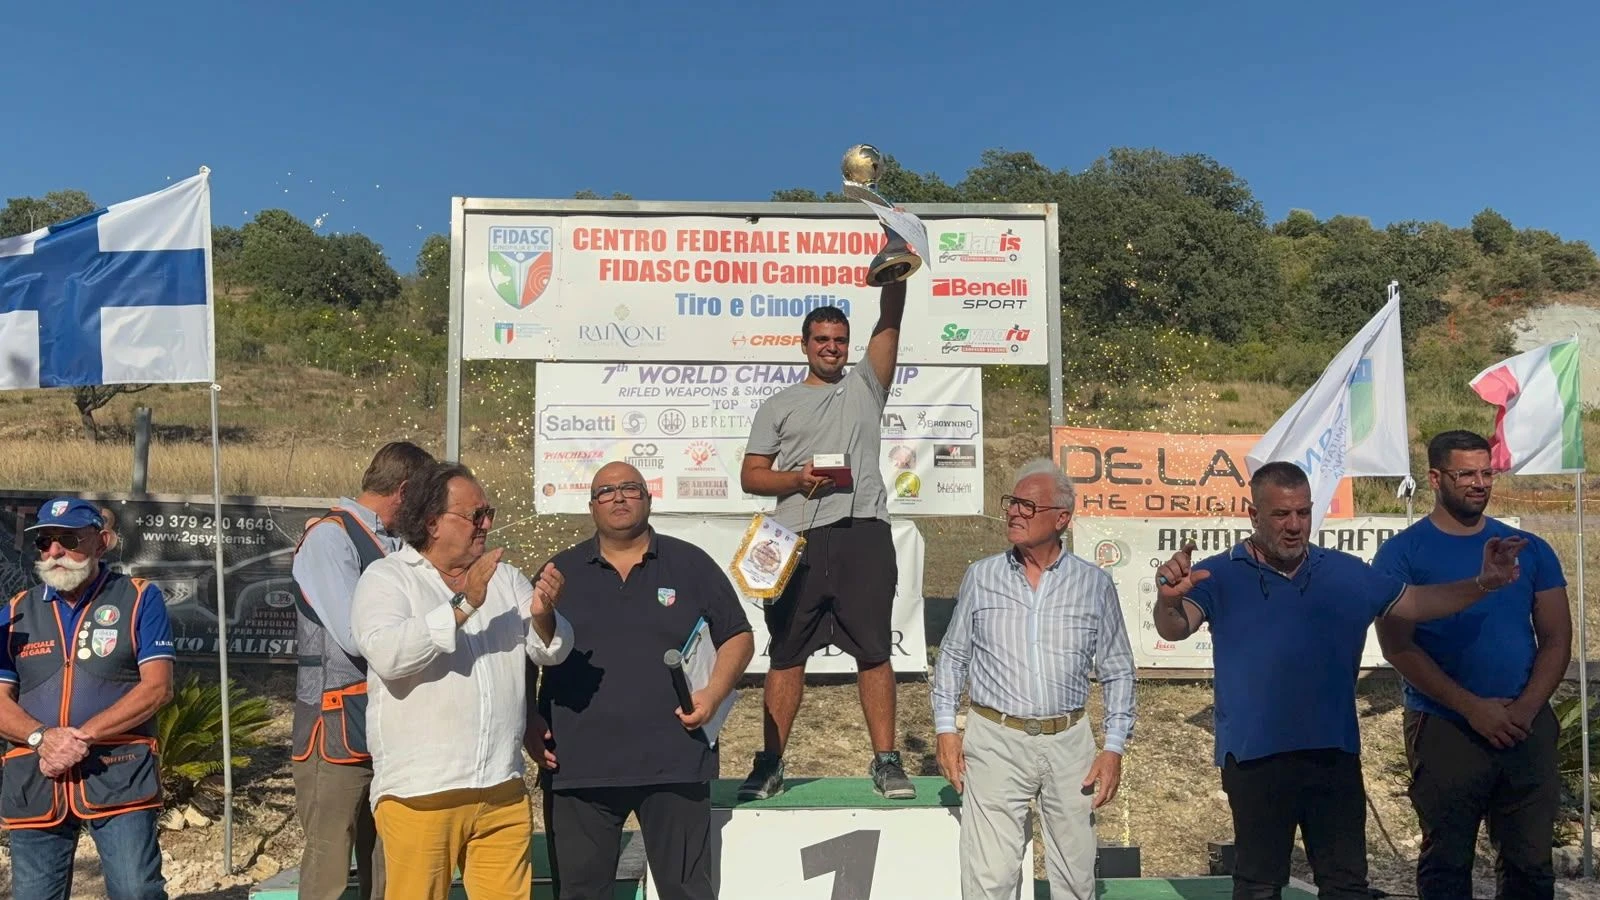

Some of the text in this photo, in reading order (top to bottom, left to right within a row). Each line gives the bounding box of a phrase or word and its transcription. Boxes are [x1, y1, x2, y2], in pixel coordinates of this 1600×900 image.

[493, 229, 549, 245] FIDASC
[572, 227, 667, 252] CENTRO
[676, 229, 790, 254] FEDERALE
[599, 258, 869, 288] FIDASC CONI Campag
[951, 278, 1028, 297] Benelli
[675, 293, 851, 317] Tiro e Cinofilia
[962, 299, 1028, 310] SPORT
[750, 334, 802, 346] CRISP
[601, 363, 629, 385] 7th
[638, 365, 728, 385] WORLD
[618, 386, 661, 398] RIFLED
[665, 386, 728, 398] WEAPONS
[731, 386, 740, 396] &
[712, 398, 739, 410] TOP
[546, 415, 753, 432] Sabatti BERETTA
[927, 420, 973, 429] BROWNING
[1083, 493, 1127, 511] HE
[135, 513, 274, 531] +39 379 20 4648
[143, 531, 266, 546] www.2gsystems.it
[1318, 528, 1404, 551] CAFA
[244, 619, 296, 627] PERFORMA
[29, 647, 52, 656] GARA
[800, 829, 881, 900] 1
